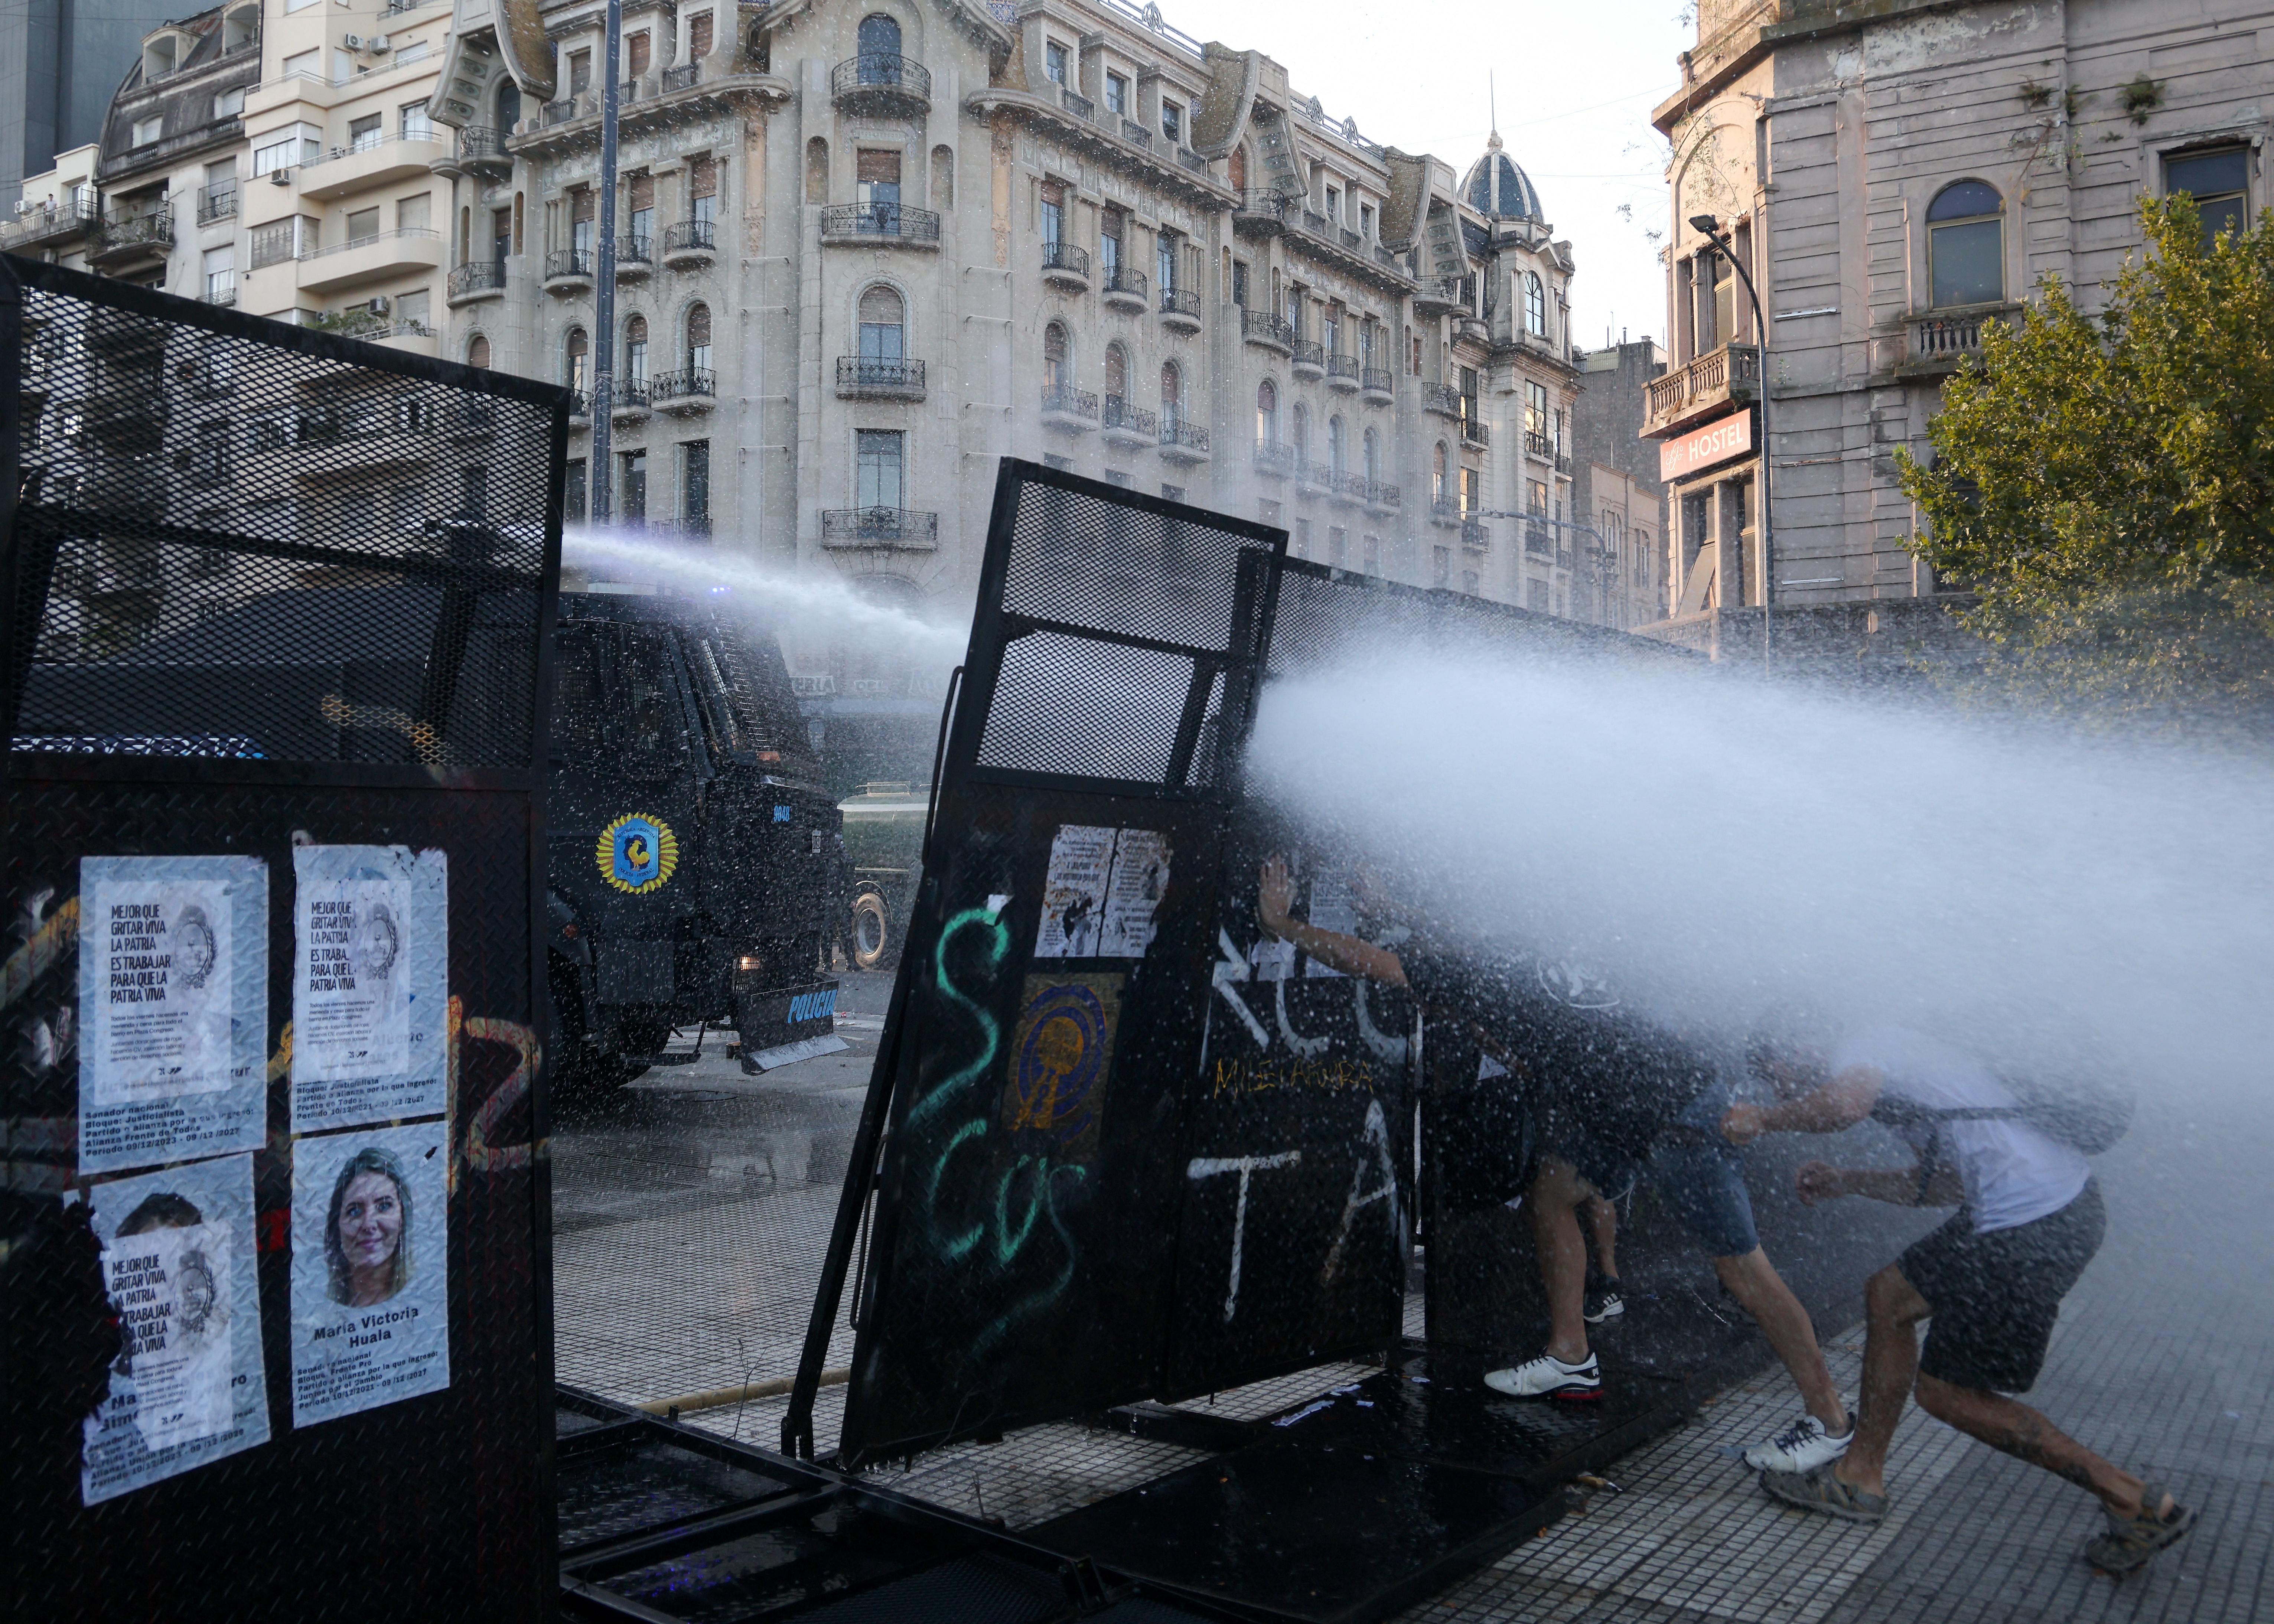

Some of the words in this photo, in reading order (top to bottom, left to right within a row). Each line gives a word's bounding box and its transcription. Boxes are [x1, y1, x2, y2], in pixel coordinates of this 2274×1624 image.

[1690, 423, 1743, 462] HOSTEL
[774, 805, 790, 822] 9048
[637, 868, 654, 877] FEDERAL
[111, 905, 141, 919] MEJOR
[143, 904, 160, 921] QUE
[311, 901, 336, 914] MEJOR
[338, 901, 352, 916] QUE
[111, 921, 143, 936] GRITAR
[145, 920, 166, 935] VIVA
[311, 916, 338, 929] GRITAR
[339, 916, 356, 928] VIV
[111, 937, 123, 952] LA
[124, 936, 156, 951] PATRIA
[311, 931, 320, 944] LA
[322, 930, 348, 944] PATRIA
[111, 956, 121, 971] ES
[123, 954, 171, 970] TRABAJAR
[310, 949, 320, 962] ES
[111, 972, 136, 988] PARA
[137, 971, 155, 988] QUE
[156, 970, 167, 985] LA
[310, 963, 331, 976] PARA
[333, 963, 347, 978] QUE
[310, 978, 337, 992] PATRIA
[338, 977, 356, 990] VIVA
[111, 988, 143, 1004] PATRIA
[144, 987, 166, 1002] VIVA
[787, 989, 837, 1024] POLICIA
[297, 1086, 327, 1094] Bloque:
[391, 1083, 405, 1091] que
[407, 1078, 437, 1089] ingresó:
[85, 1108, 126, 1119] Senador
[128, 1102, 169, 1113] nacional
[297, 1103, 324, 1112] Frente
[85, 1119, 122, 1129] Bloque:
[125, 1109, 185, 1123] Justicialista
[85, 1127, 121, 1138] Partido
[133, 1121, 167, 1131] alianza
[170, 1118, 185, 1127] por
[85, 1137, 122, 1148] Alianza
[125, 1132, 155, 1141] Frente
[173, 1125, 201, 1134] Todos
[126, 1137, 176, 1151] 09/12/2023
[186, 1134, 197, 1142] 09
[199, 1131, 213, 1140] /12
[216, 1127, 240, 1137] /2027
[112, 1258, 141, 1276] MEJOR
[143, 1253, 160, 1272] QUE
[112, 1274, 143, 1292] GRITAR
[144, 1269, 167, 1286] VIVA
[126, 1287, 156, 1306] PATRIA
[124, 1302, 171, 1324] TRABAJAR
[361, 1306, 419, 1329] Victoria
[137, 1321, 155, 1341] QUE
[156, 1320, 168, 1335] LA
[349, 1329, 391, 1349] Huala
[144, 1336, 166, 1354] VIVA
[338, 1351, 371, 1365] nacional
[298, 1380, 327, 1393] Partido
[338, 1370, 365, 1383] alianza
[368, 1366, 381, 1376] por
[392, 1359, 406, 1369] que
[408, 1350, 438, 1363] ingresó:
[330, 1364, 356, 1375] Frente
[359, 1360, 372, 1368] Pro
[393, 1374, 404, 1384] /12
[407, 1367, 427, 1380] /2027
[298, 1389, 326, 1401] Juntos
[329, 1385, 341, 1395] por
[344, 1380, 351, 1389] el
